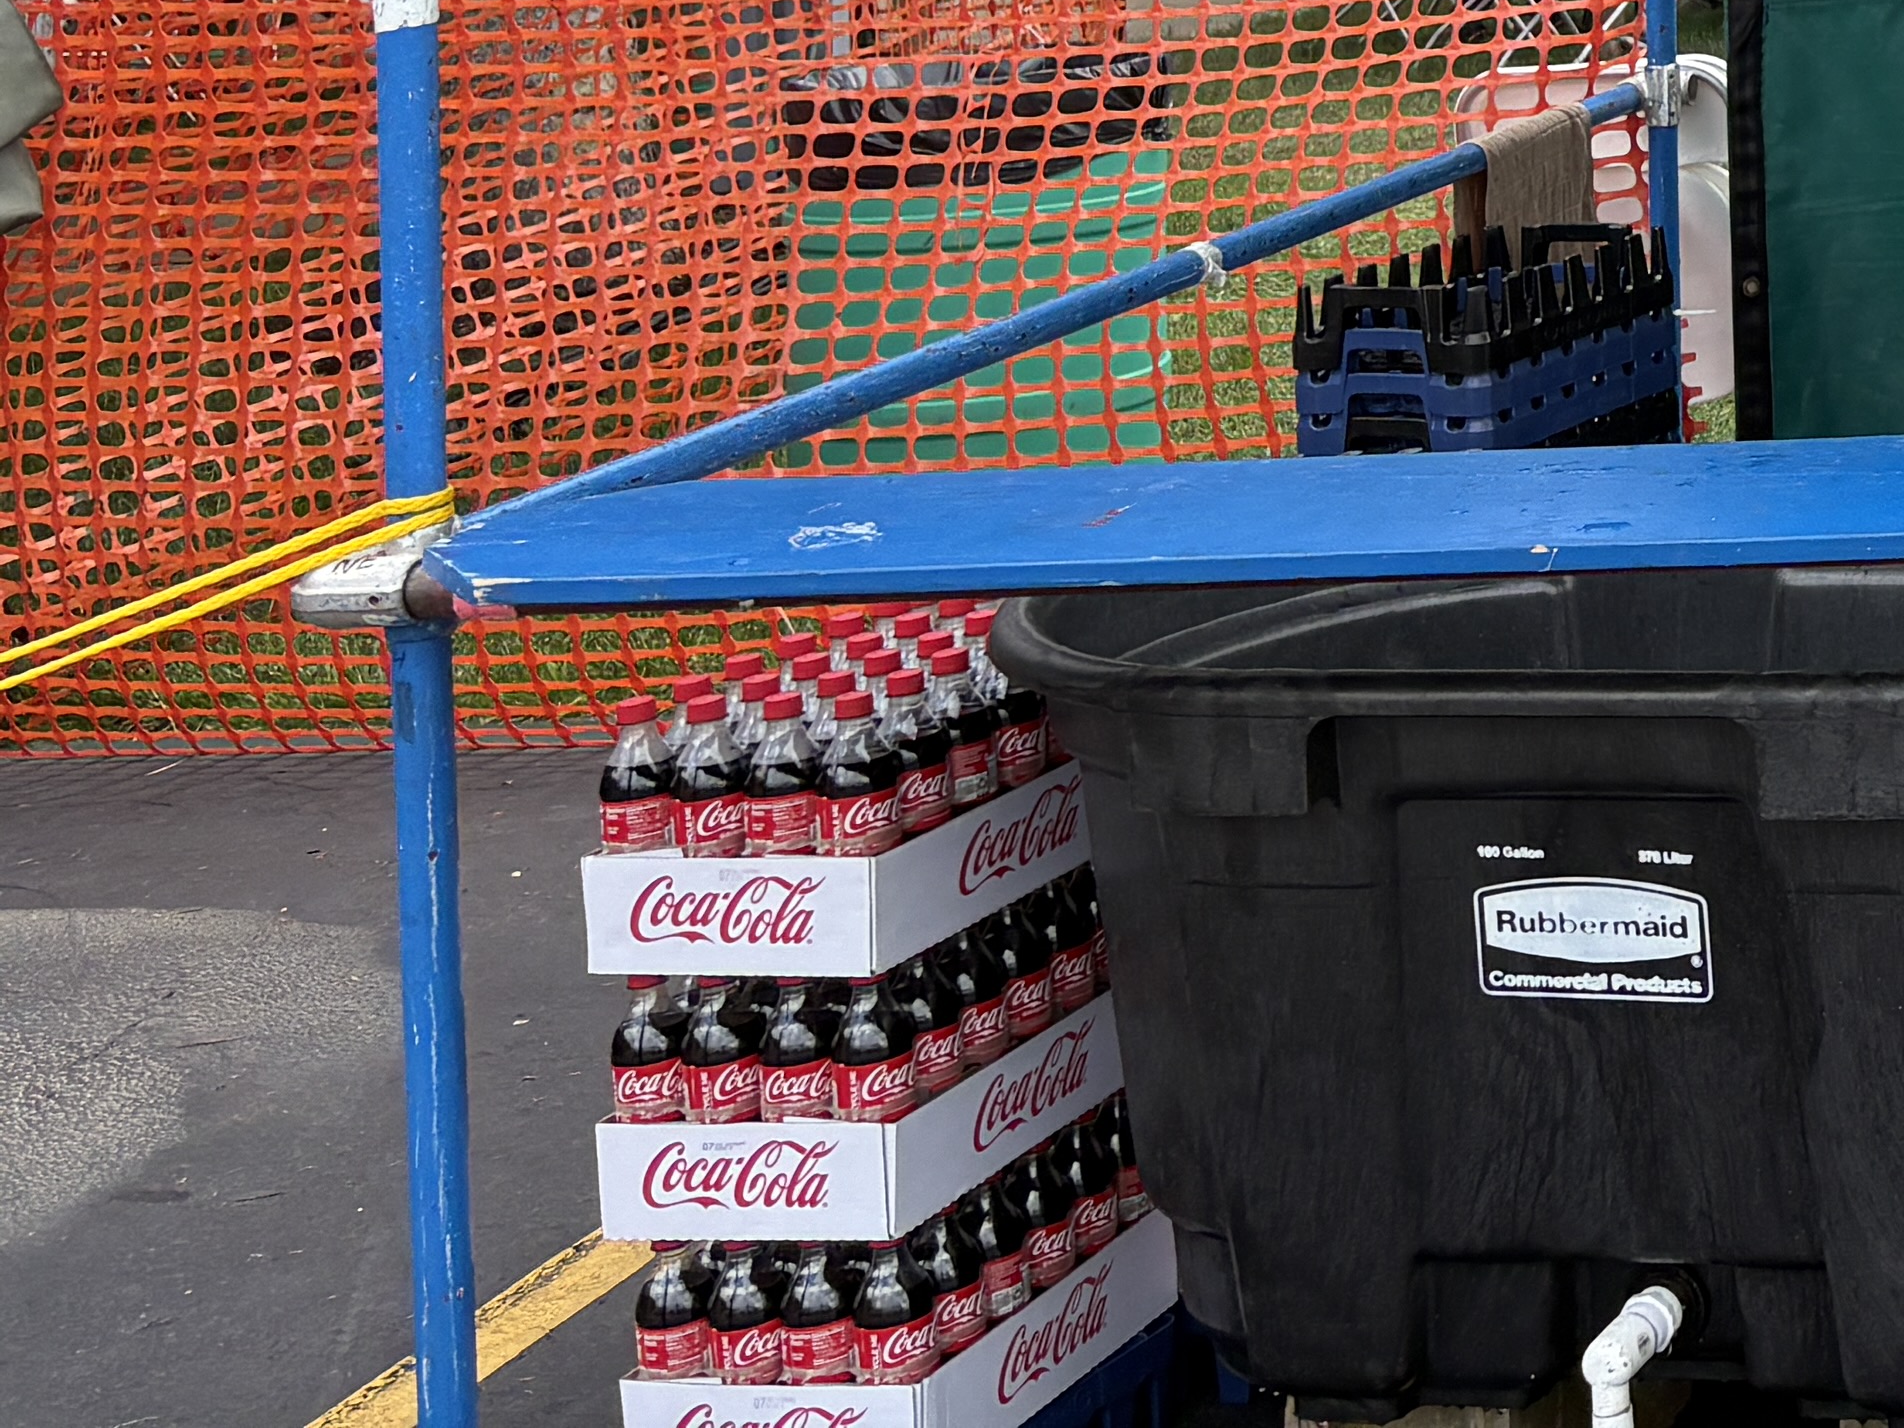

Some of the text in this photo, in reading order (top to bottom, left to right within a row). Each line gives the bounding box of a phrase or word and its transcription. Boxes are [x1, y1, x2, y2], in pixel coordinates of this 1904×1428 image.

[959, 774, 1083, 896] Coca-Cola
[1502, 846, 1545, 859] Gallon
[630, 875, 826, 945] Coca-Cola
[1496, 910, 1689, 939] Rubbermaid
[1489, 970, 1703, 994] Commercial Products
[974, 1015, 1096, 1152] Coca-Cola
[643, 1140, 840, 1210] Coca-Cola
[998, 1258, 1114, 1405] Coca-Cola
